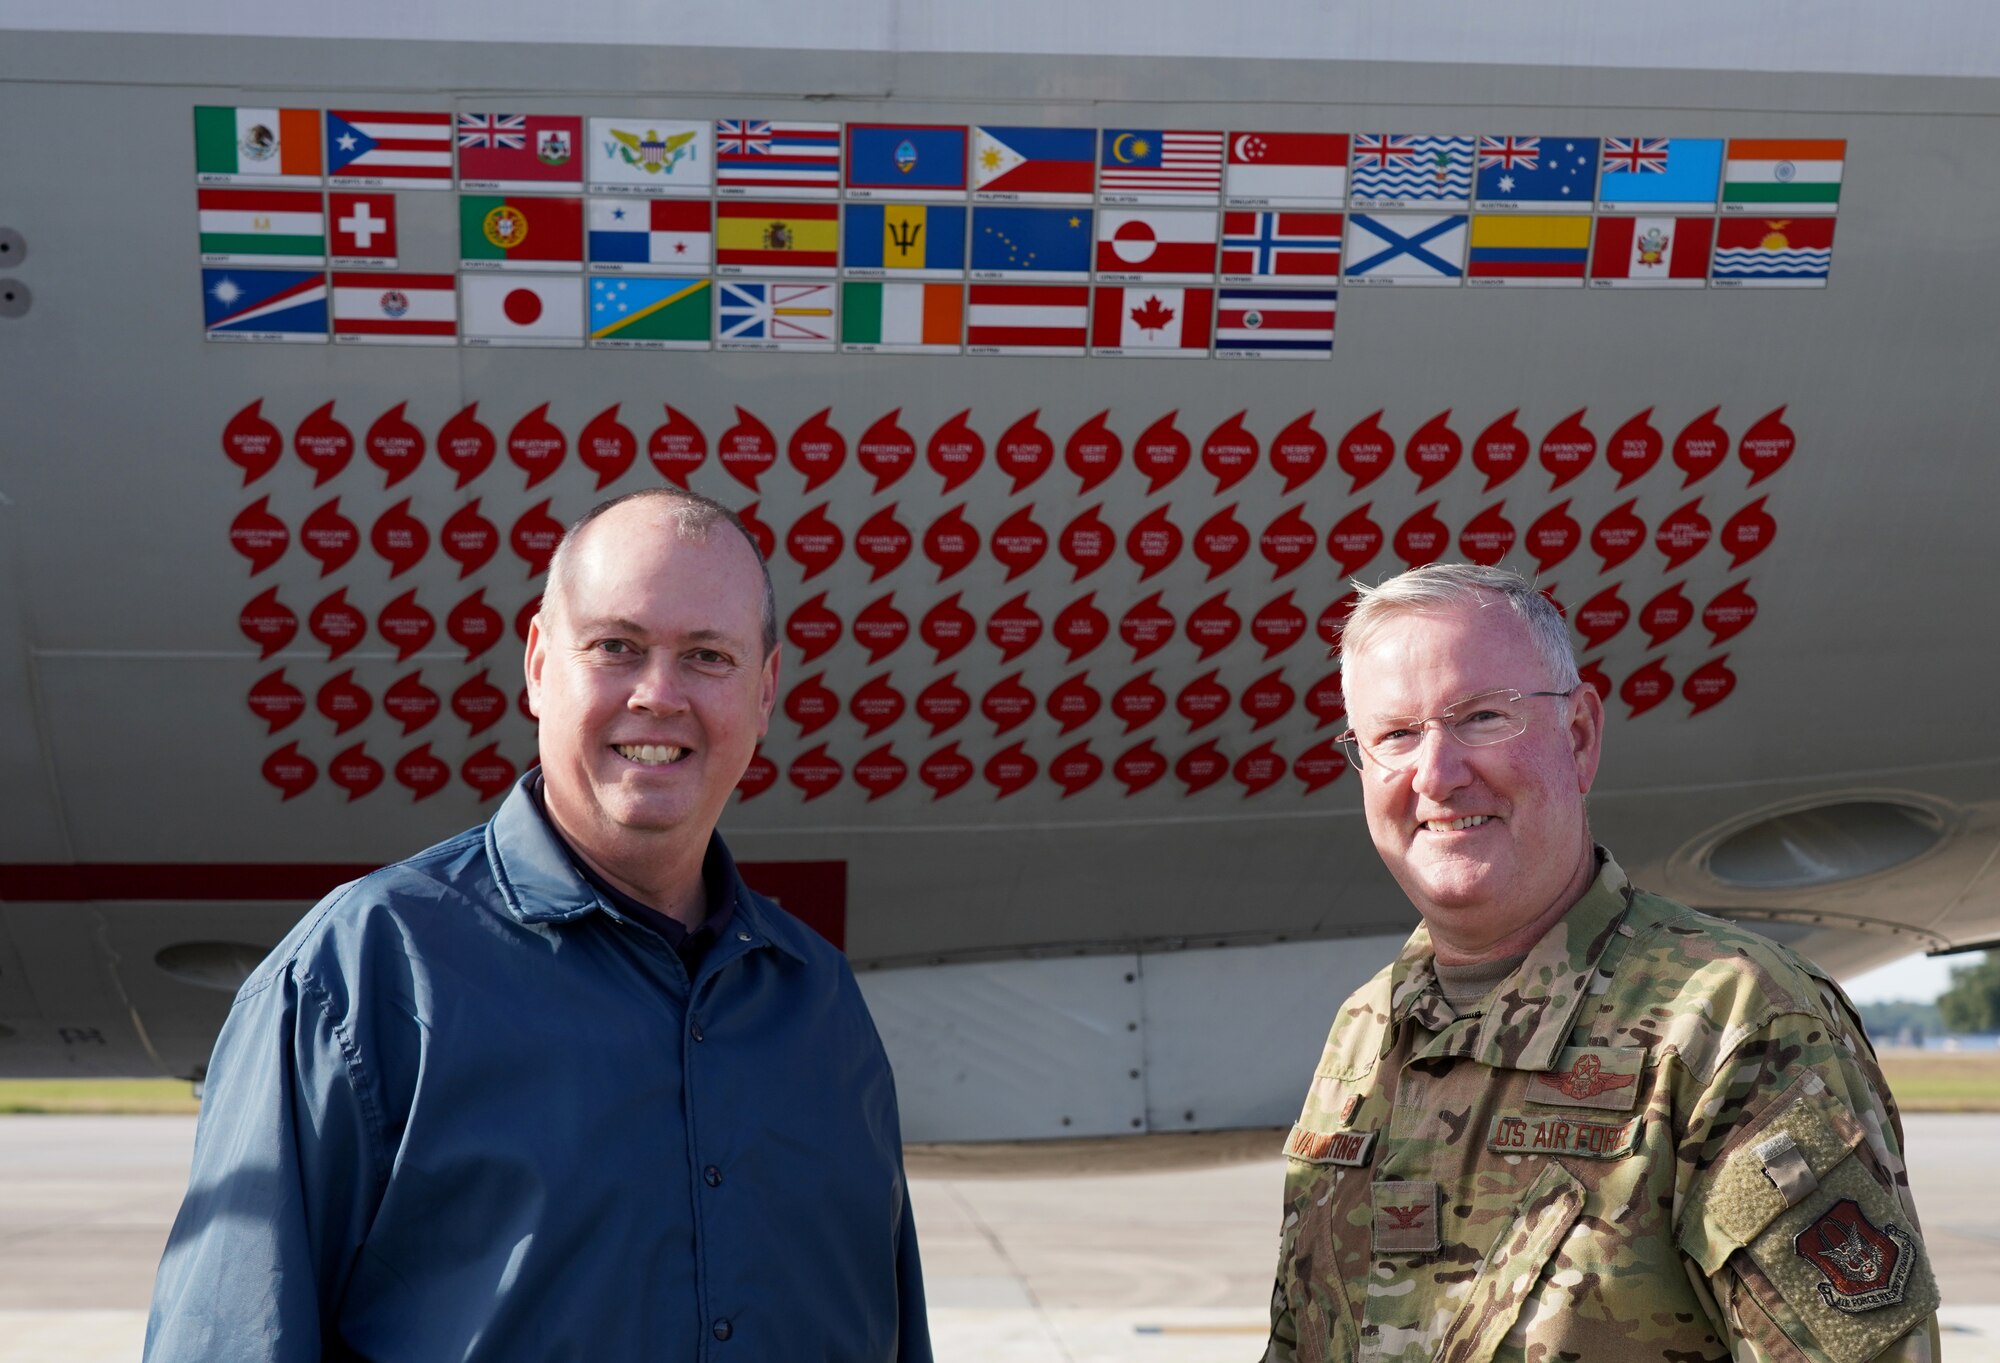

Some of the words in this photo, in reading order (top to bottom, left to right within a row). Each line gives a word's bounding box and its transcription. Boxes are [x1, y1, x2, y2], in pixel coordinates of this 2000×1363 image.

[1496, 1119, 1527, 1146] U.S.
[1533, 1121, 1569, 1149] AIR
[1836, 1297, 1850, 1308] AIR
[1852, 1295, 1878, 1306] FORCE
